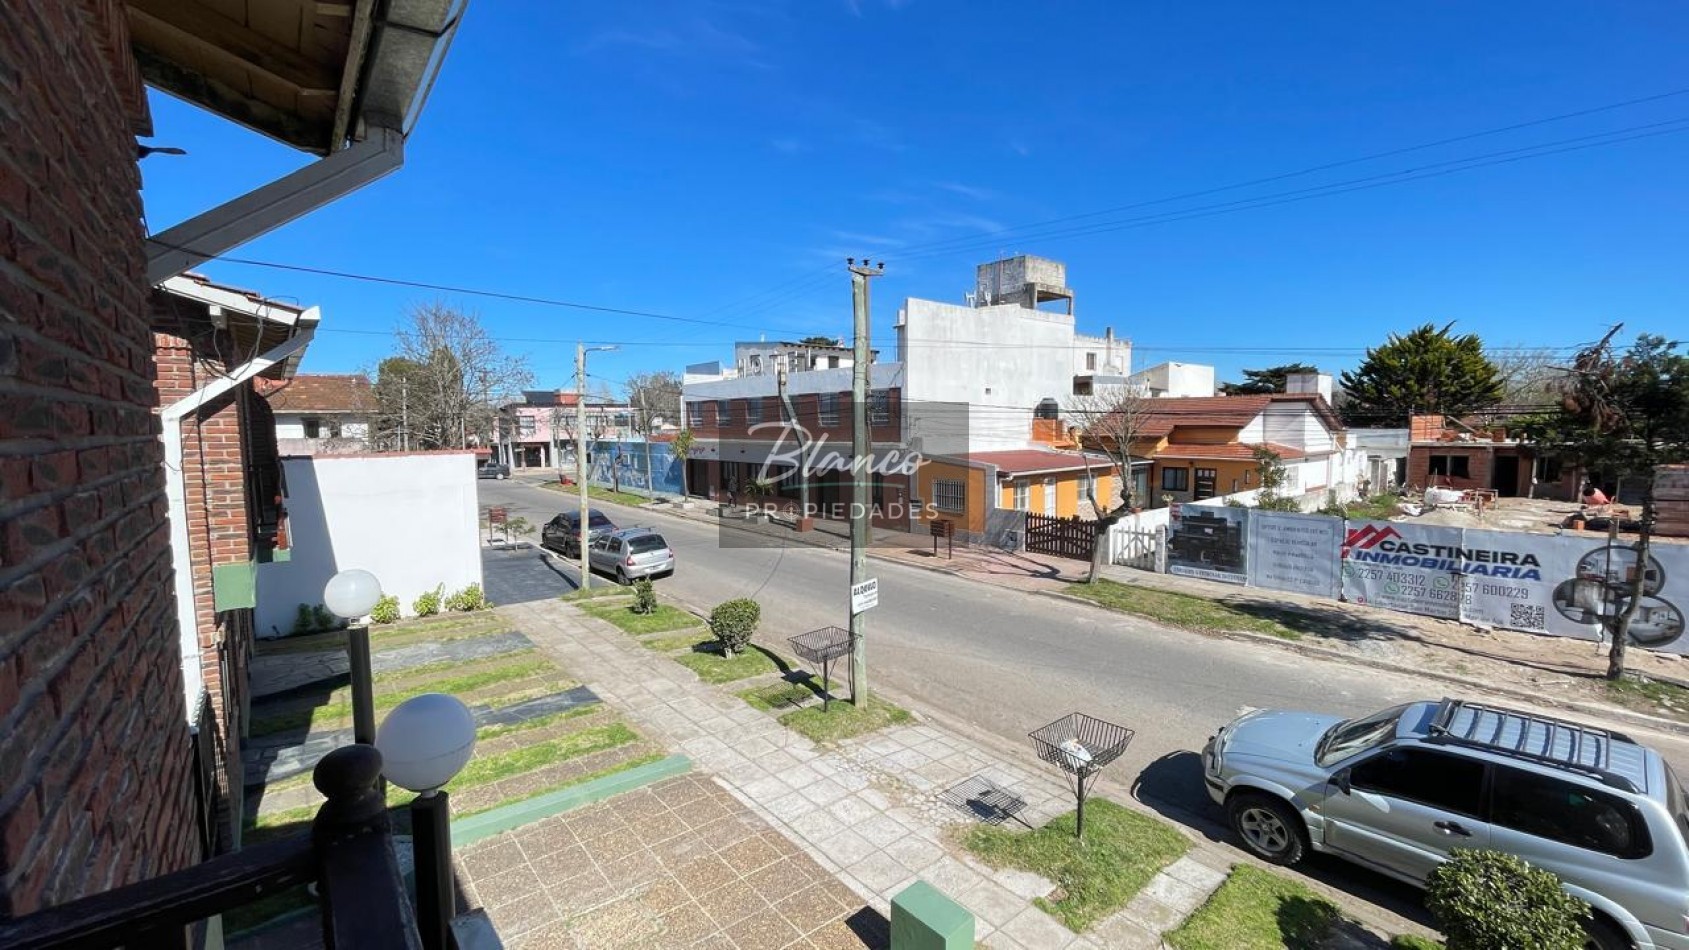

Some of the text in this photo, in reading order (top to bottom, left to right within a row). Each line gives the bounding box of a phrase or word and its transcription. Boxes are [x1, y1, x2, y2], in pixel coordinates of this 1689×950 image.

[1355, 550, 1541, 581] INMOBILIARIA
[1402, 585, 1426, 598] 2257
[1482, 584, 1529, 600] 600229
